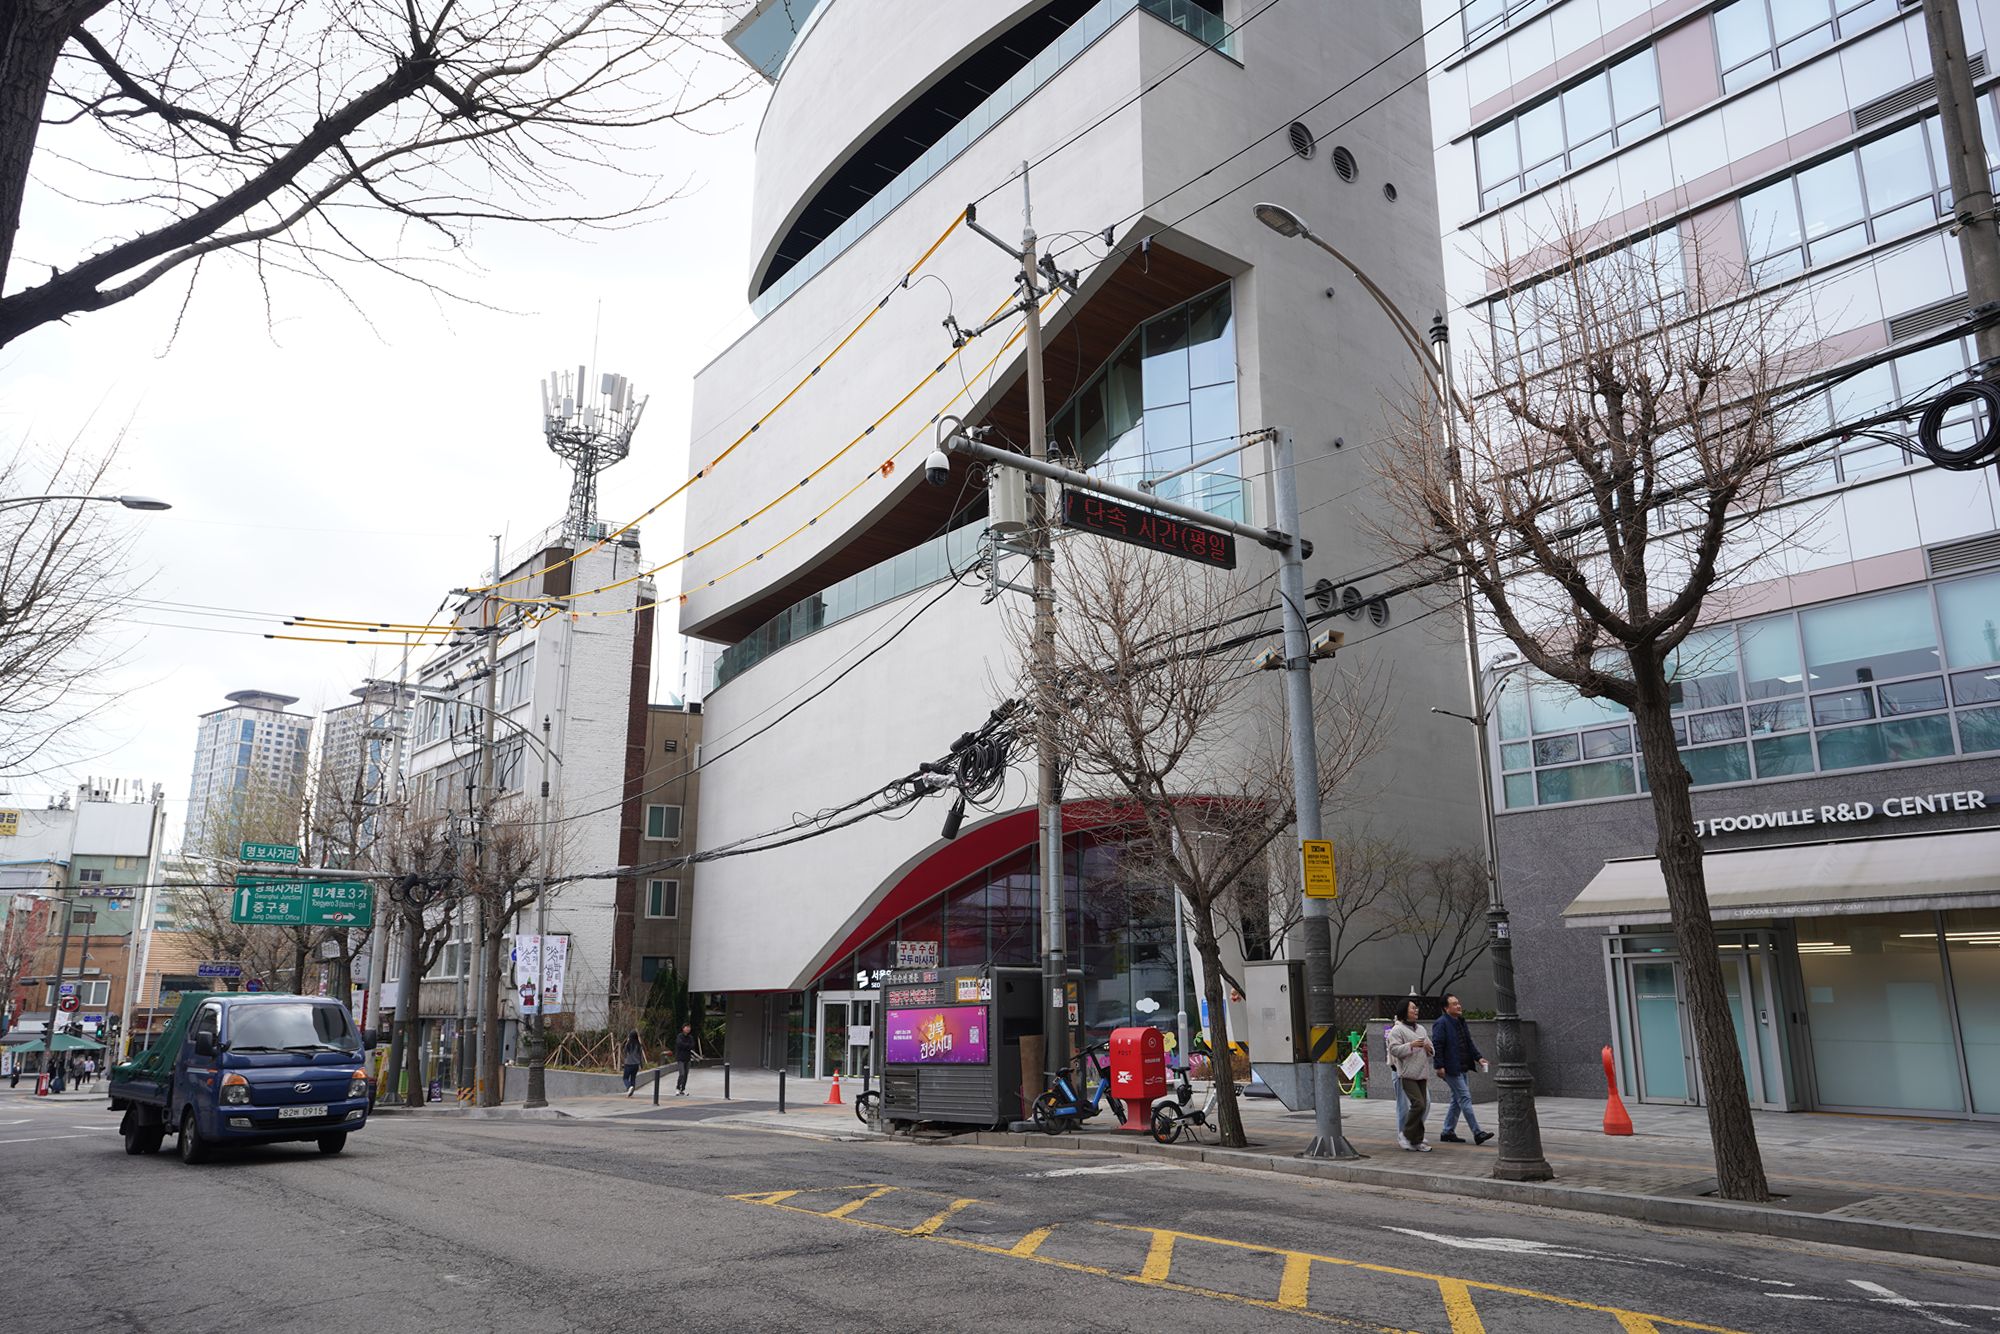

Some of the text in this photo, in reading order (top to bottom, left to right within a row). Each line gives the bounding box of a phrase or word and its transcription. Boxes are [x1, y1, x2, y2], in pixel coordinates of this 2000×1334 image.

[1084, 498, 1128, 535] 단속
[1138, 515, 1226, 562] 시간(평일
[1693, 789, 1987, 838] J FOODVILLE R&D CENTER
[245, 845, 296, 861] 명보사거리
[252, 901, 290, 914] 중구청
[900, 943, 936, 955] 구두수선
[900, 954, 936, 966] 구두마사지
[927, 1020, 945, 1039] 강북
[921, 1033, 953, 1060] 전성시대
[302, 1107, 323, 1115] 0915
